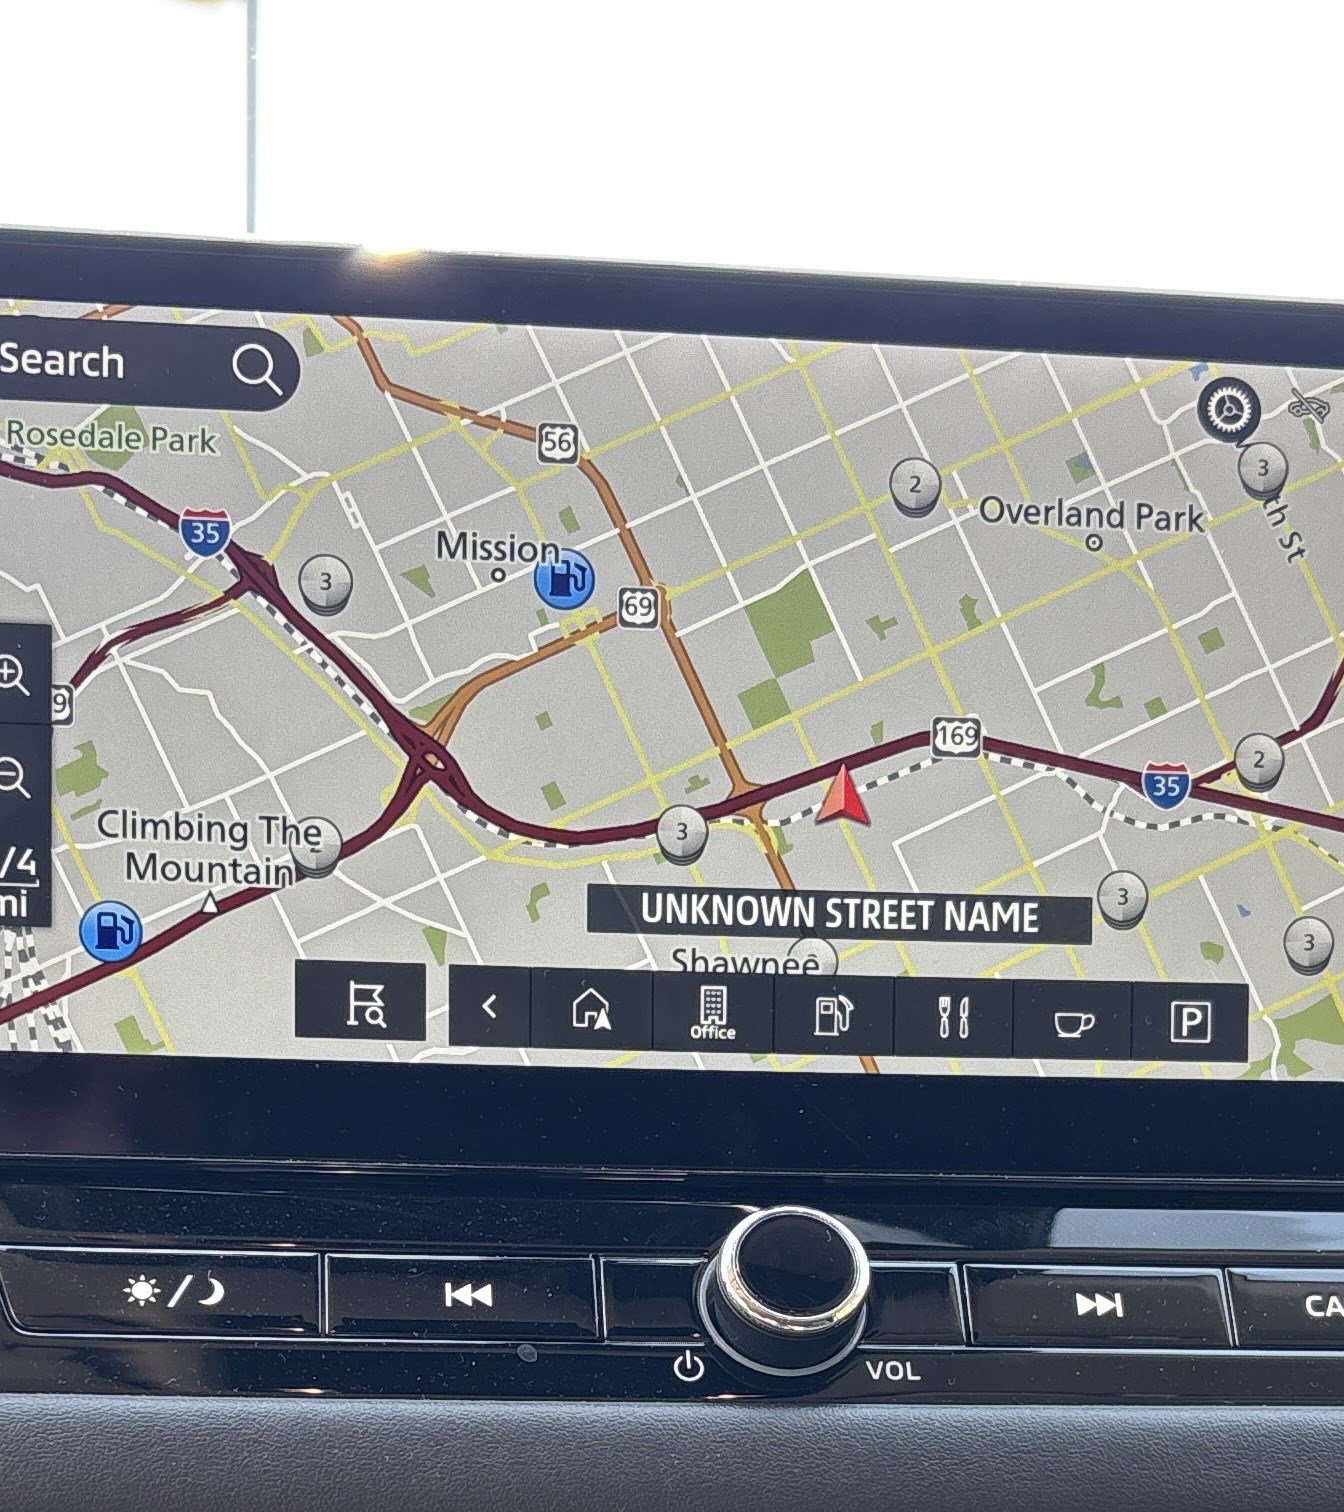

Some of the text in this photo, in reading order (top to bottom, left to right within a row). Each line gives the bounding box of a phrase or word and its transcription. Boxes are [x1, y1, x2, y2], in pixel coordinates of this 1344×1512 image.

[0, 342, 124, 379] Search
[7, 420, 217, 454] Rosedale Park
[544, 433, 571, 453] 56
[1258, 460, 1269, 476] 3
[910, 476, 921, 493] 2
[980, 496, 1205, 533] Overland Park
[191, 523, 220, 543] 35
[437, 530, 559, 563] Mission
[1279, 532, 1306, 563] St
[320, 573, 331, 590] 3
[625, 597, 652, 617] 69
[937, 725, 977, 746] 169
[1254, 751, 1264, 768] 2
[1154, 776, 1180, 796] 35
[98, 809, 322, 851] Climbing The
[677, 824, 687, 840] 3
[127, 852, 294, 886] Mountain
[1118, 889, 1128, 905] 3
[642, 892, 1039, 934] UNKNOWN STREET NAME
[1304, 934, 1314, 950] 3
[690, 1025, 736, 1040] Office
[1182, 1008, 1202, 1037] P
[866, 1359, 922, 1381] VOL
